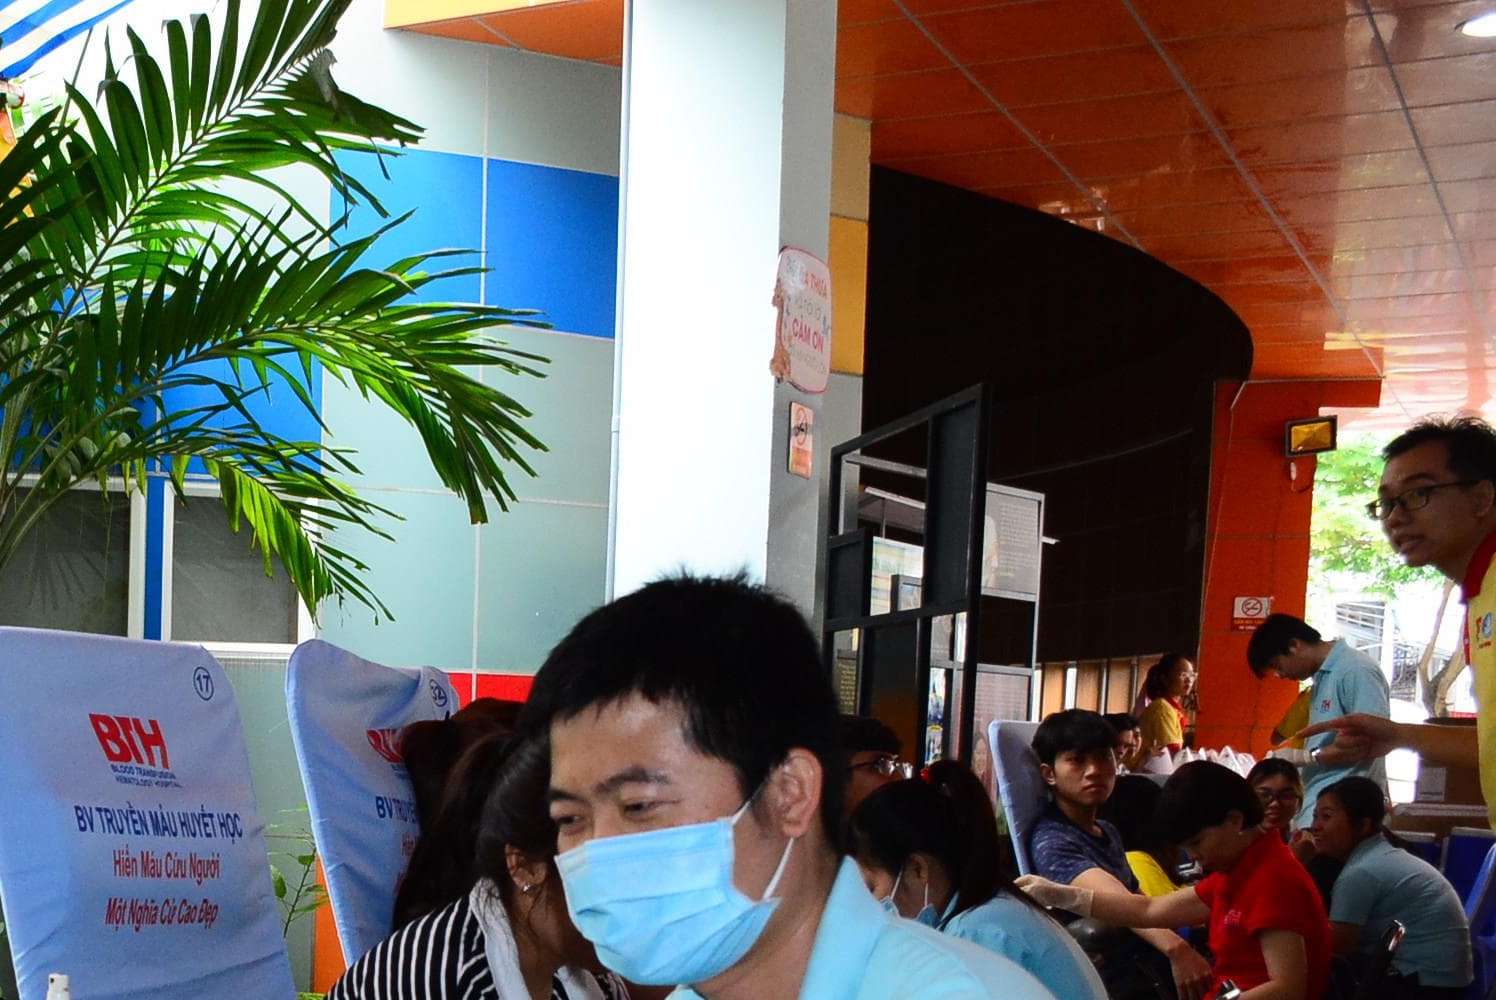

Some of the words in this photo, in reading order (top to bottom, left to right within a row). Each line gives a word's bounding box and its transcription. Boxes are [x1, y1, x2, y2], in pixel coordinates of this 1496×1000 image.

[196, 674, 211, 692] 17
[89, 713, 169, 769] BTH
[74, 805, 94, 833] BV
[96, 801, 149, 836] TRUYỀN
[149, 804, 178, 838] MÁU
[178, 804, 217, 838] HUYẾT
[217, 812, 243, 844] HỌC
[376, 796, 393, 819] BV
[113, 844, 138, 877] Hiến
[141, 850, 162, 878] Máu
[165, 851, 186, 878] Cứu
[105, 897, 125, 931] Một
[178, 898, 196, 924] Cao
